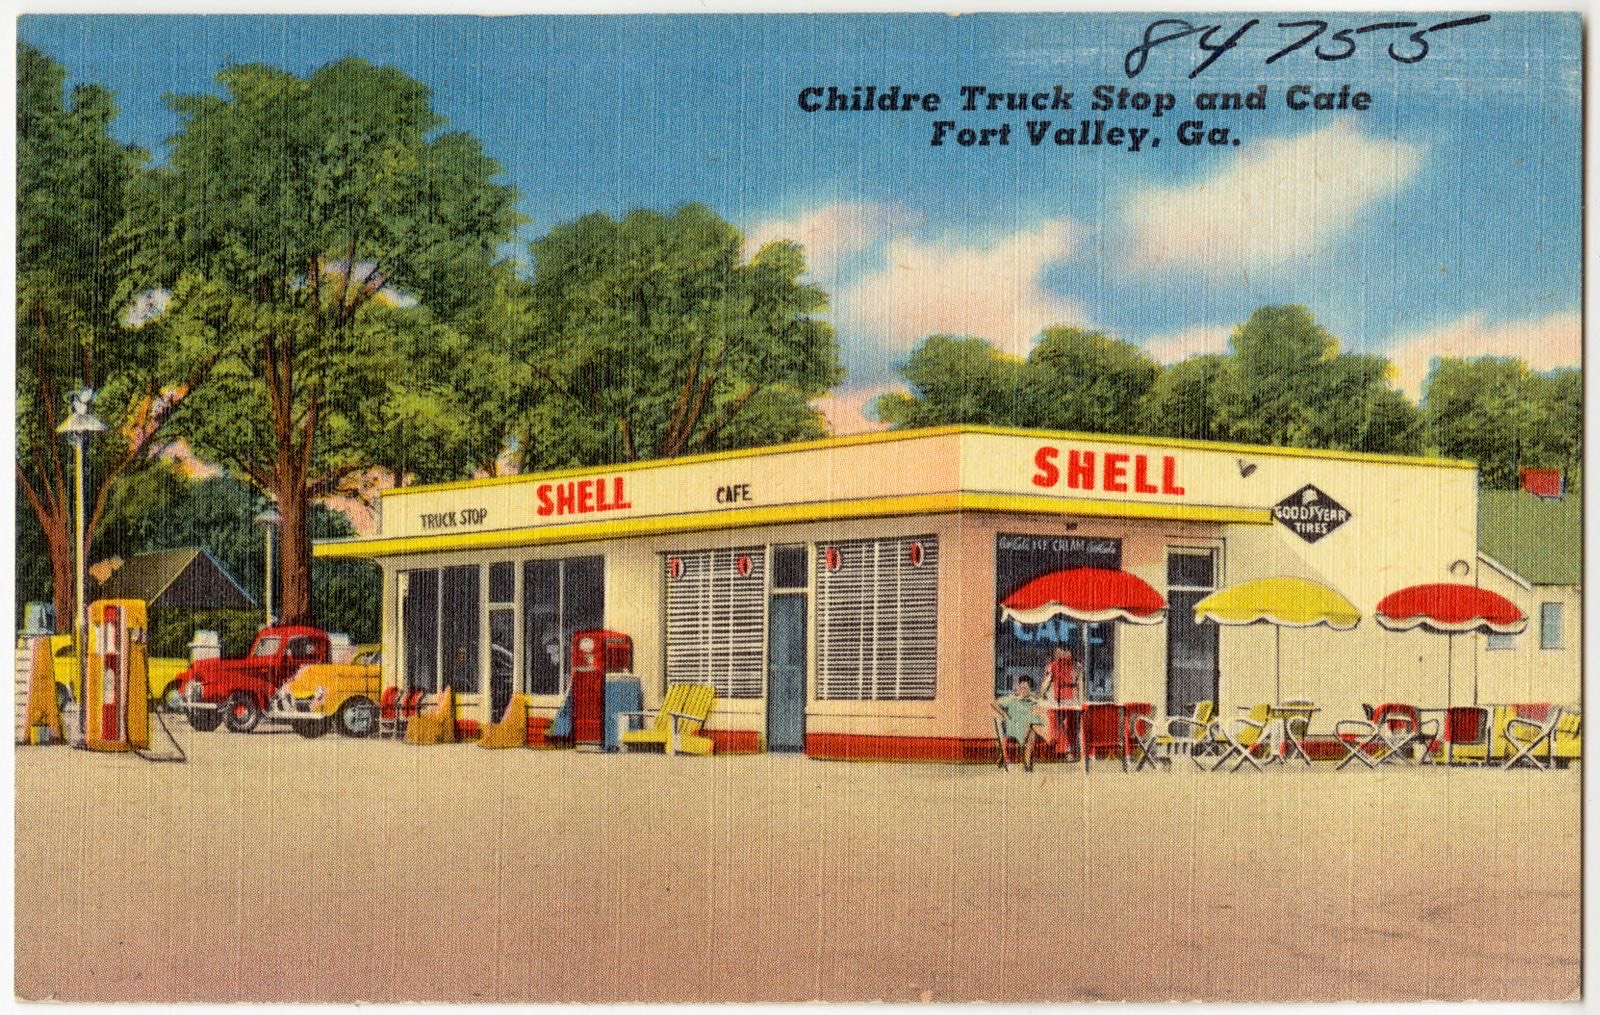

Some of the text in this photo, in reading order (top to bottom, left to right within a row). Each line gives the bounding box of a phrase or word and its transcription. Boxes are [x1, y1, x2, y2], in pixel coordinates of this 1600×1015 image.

[1124, 14, 1491, 78] 84755
[1031, 445, 1186, 496] SHELL
[536, 476, 632, 516] SHELL
[715, 483, 752, 504] CAFE
[420, 507, 488, 529] TRUCK STOP
[1294, 521, 1328, 535] TIRES
